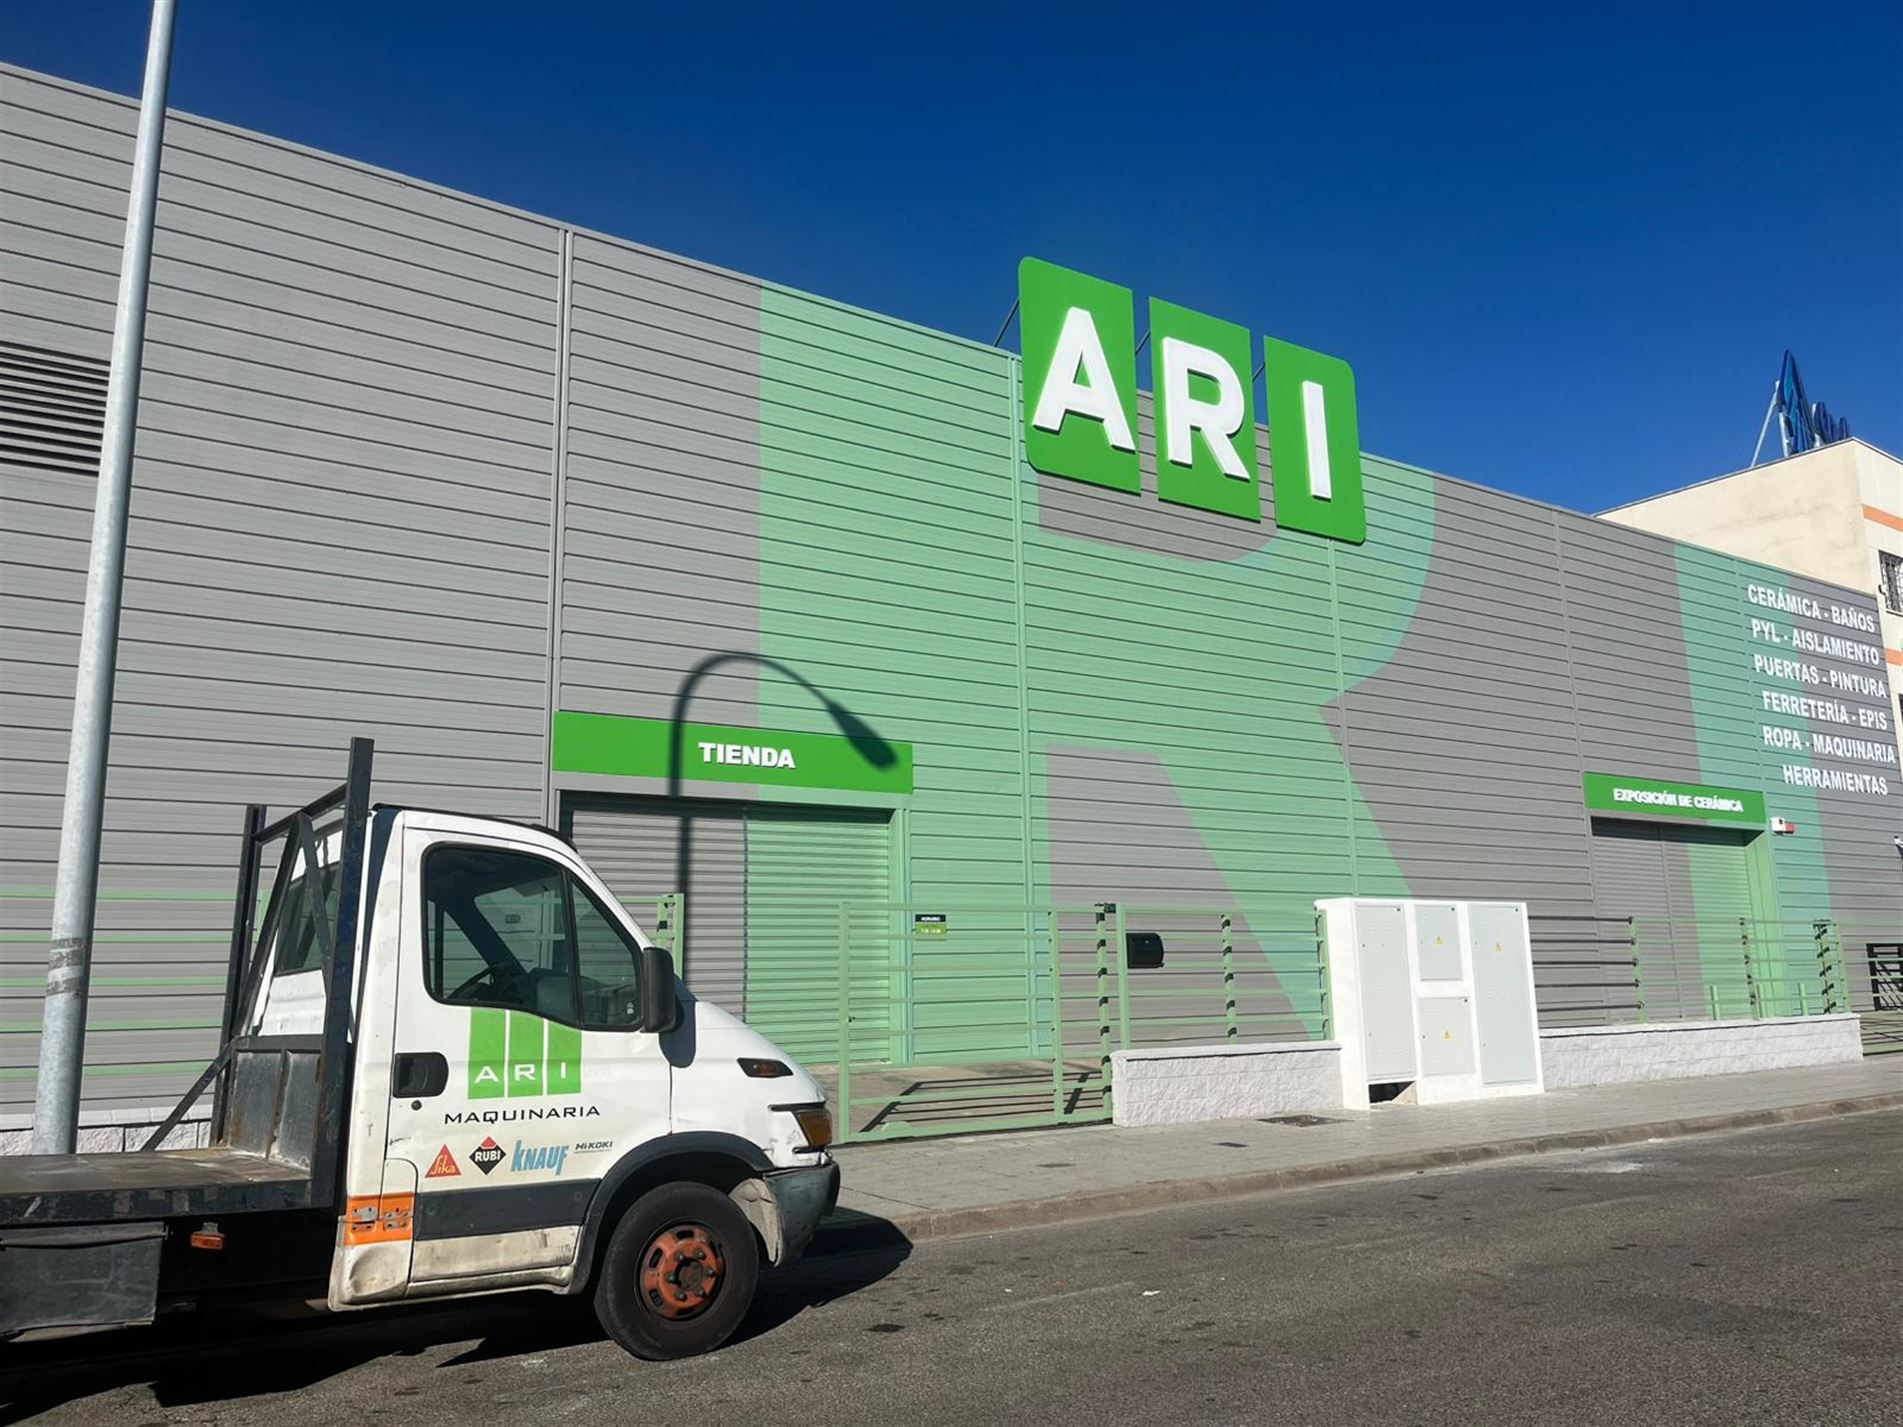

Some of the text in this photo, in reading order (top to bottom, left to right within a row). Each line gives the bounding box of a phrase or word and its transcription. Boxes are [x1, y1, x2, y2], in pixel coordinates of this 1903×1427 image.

[1032, 305, 1332, 502] ARI
[1748, 584, 1821, 619] CERÁMICA
[1831, 606, 1875, 632] BAÑOS
[1752, 618, 1780, 643] PYL
[1792, 628, 1880, 665] AISLAMIENTO
[1754, 654, 1819, 685] PUERTAS
[1829, 670, 1887, 698] PINTURA
[1762, 690, 1849, 724] FERRETERÍA
[1859, 709, 1888, 730] EPIS
[698, 742, 796, 769] TIENDA
[1762, 726, 1802, 750] ROPA
[1812, 734, 1896, 763] MAQUINARIA
[1783, 764, 1888, 796] HERRAMIENTAS
[1613, 788, 1744, 812] EXPOSICIÓN DE CERÁMICA
[474, 1062, 567, 1084] ARI
[444, 1105, 600, 1125] MAQUINARIA
[430, 1155, 456, 1175] Sika
[474, 1150, 500, 1162] RUBI
[511, 1140, 569, 1176] KNAUF
